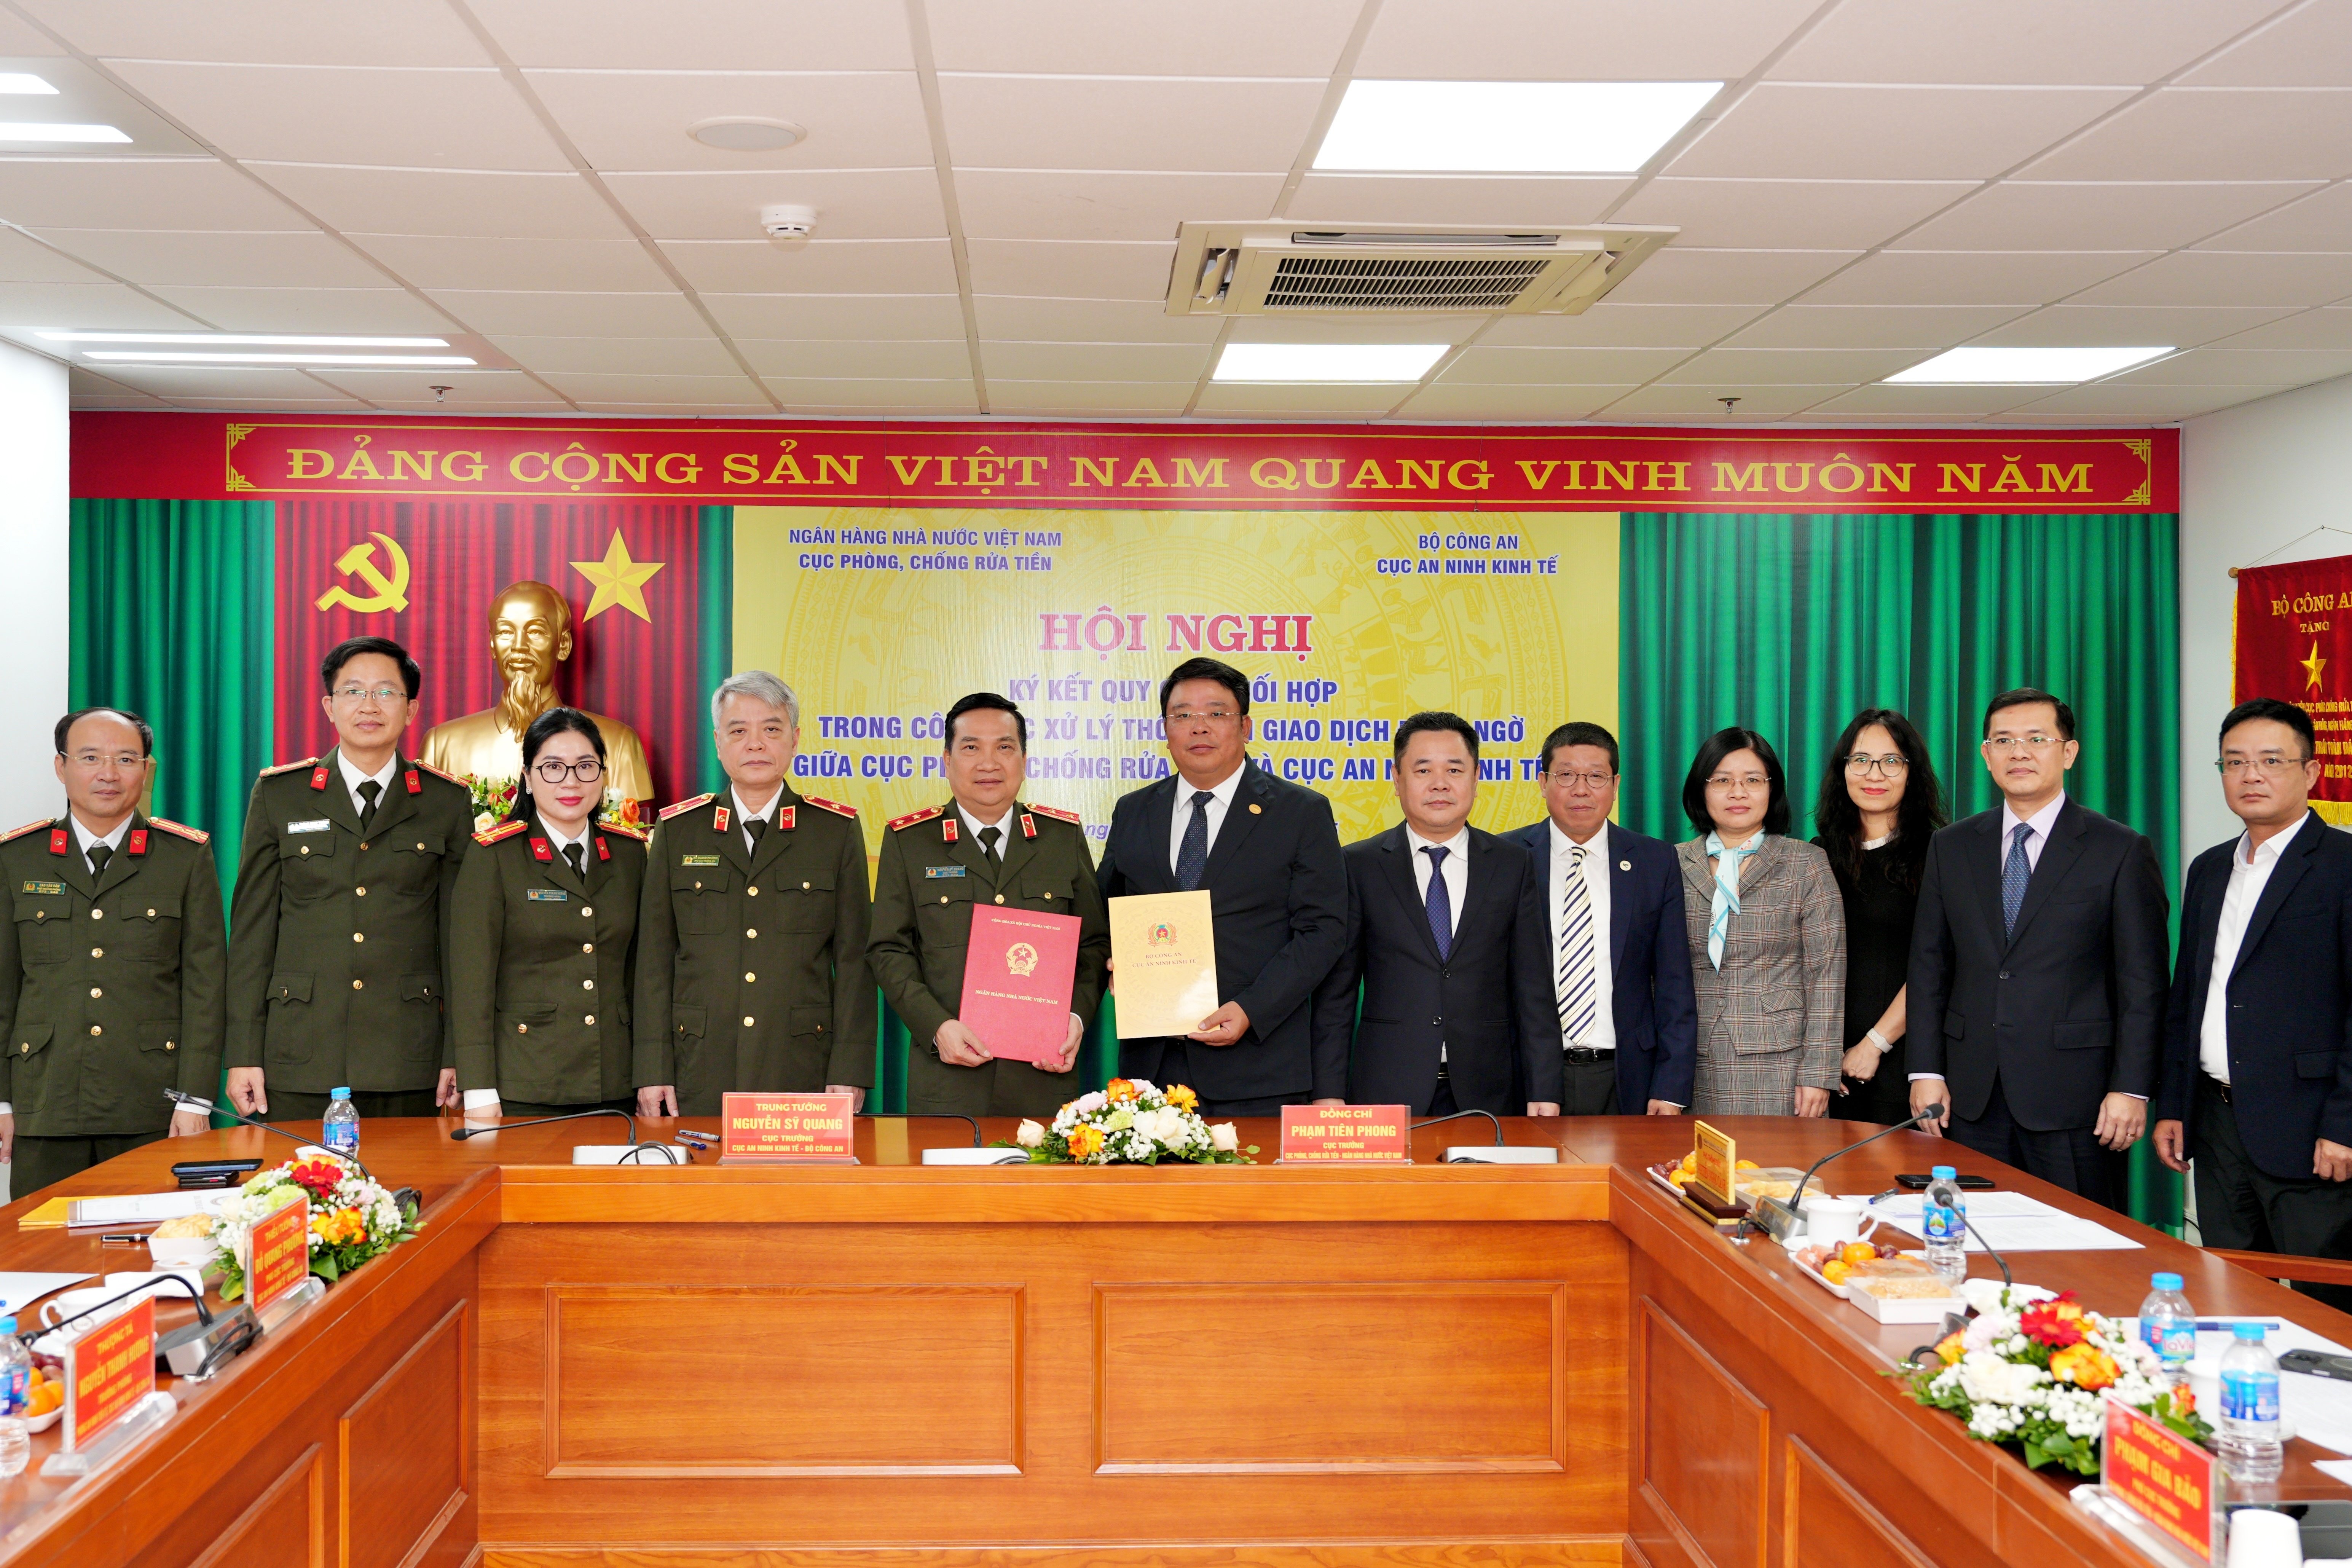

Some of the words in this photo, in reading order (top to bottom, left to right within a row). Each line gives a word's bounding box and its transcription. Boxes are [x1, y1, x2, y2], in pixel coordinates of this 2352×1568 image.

[287, 434, 461, 483] ĐẢNG
[509, 442, 703, 491] CỘNG
[722, 439, 863, 485] SẢN
[885, 446, 1048, 494] VIỆT
[1068, 457, 1230, 489] NAM
[1249, 458, 1494, 491] QUANG
[1515, 461, 1691, 491] VINH
[1711, 453, 1916, 493] MUÔN
[1937, 455, 2093, 493] NĂM
[789, 528, 835, 544] NGÂN
[841, 528, 887, 545] HÀNG
[893, 528, 927, 545] NHÀ
[933, 528, 978, 546] NƯỚC
[984, 529, 1019, 549] VIỆT
[1025, 532, 1062, 547] NAM
[1419, 532, 1441, 552] BỘ
[1446, 532, 1491, 550] CÔNG
[1496, 536, 1519, 549] AN
[799, 554, 835, 571] CỤC
[840, 552, 904, 572] PHÒNG,
[910, 551, 969, 570] CHỐNG
[975, 552, 1009, 570] RỬA
[1014, 552, 1052, 571] TIỀN
[1377, 559, 1412, 577] CỤC
[1418, 559, 1440, 574] AN
[1446, 560, 1486, 574] NINH
[1492, 560, 1532, 574] KINH
[1537, 555, 1558, 574] TẾ
[2271, 594, 2290, 619] BỘ
[2293, 592, 2334, 614] CÔNG
[2337, 591, 2352, 609] A
[1040, 606, 1147, 660] HỘI
[1167, 615, 1313, 662] NGHỊ
[2299, 621, 2330, 635] TẶNG
[1009, 674, 1040, 701] KÝ
[1048, 672, 1094, 702] KẾT
[1102, 680, 1152, 704] QUY
[1249, 673, 1278, 703] ỐI
[1287, 678, 1338, 708] HỢP
[818, 716, 903, 739] TRONG
[911, 712, 947, 739] CÔ
[1044, 712, 1079, 740] XỬ
[1086, 713, 1115, 741] LÝ
[1121, 715, 1168, 741] THÔ
[1263, 719, 1322, 742] GIAO
[1330, 720, 1390, 747] DỊCH
[1474, 715, 1525, 743] NGỜ
[793, 750, 854, 778] GIỮA
[861, 755, 914, 783] CỤC
[1026, 749, 1112, 780] CHỐNG
[1121, 751, 1171, 780] RỬA
[1283, 758, 1335, 785] CỤC
[1343, 759, 1376, 780] AN
[756, 1103, 790, 1112] TRUNG
[791, 1102, 827, 1112] TƯỚNG
[1320, 1107, 1352, 1118] ĐỒNG
[1354, 1108, 1373, 1118] CHÍ
[733, 1114, 781, 1130] NGUYỄN
[785, 1116, 800, 1130] SỸ
[803, 1118, 843, 1131] QUANG
[1292, 1125, 1325, 1139] PHẠM
[1357, 1125, 1397, 1137] PHONG
[732, 1145, 745, 1153] CỤC
[792, 1143, 799, 1152] TẾ
[805, 1144, 814, 1153] BỘ
[762, 1135, 779, 1143] CỤC
[781, 1133, 814, 1142] TRƯỞNG
[1338, 1141, 1365, 1149] TRƯỞNG
[2151, 1459, 2173, 1491] GIA
